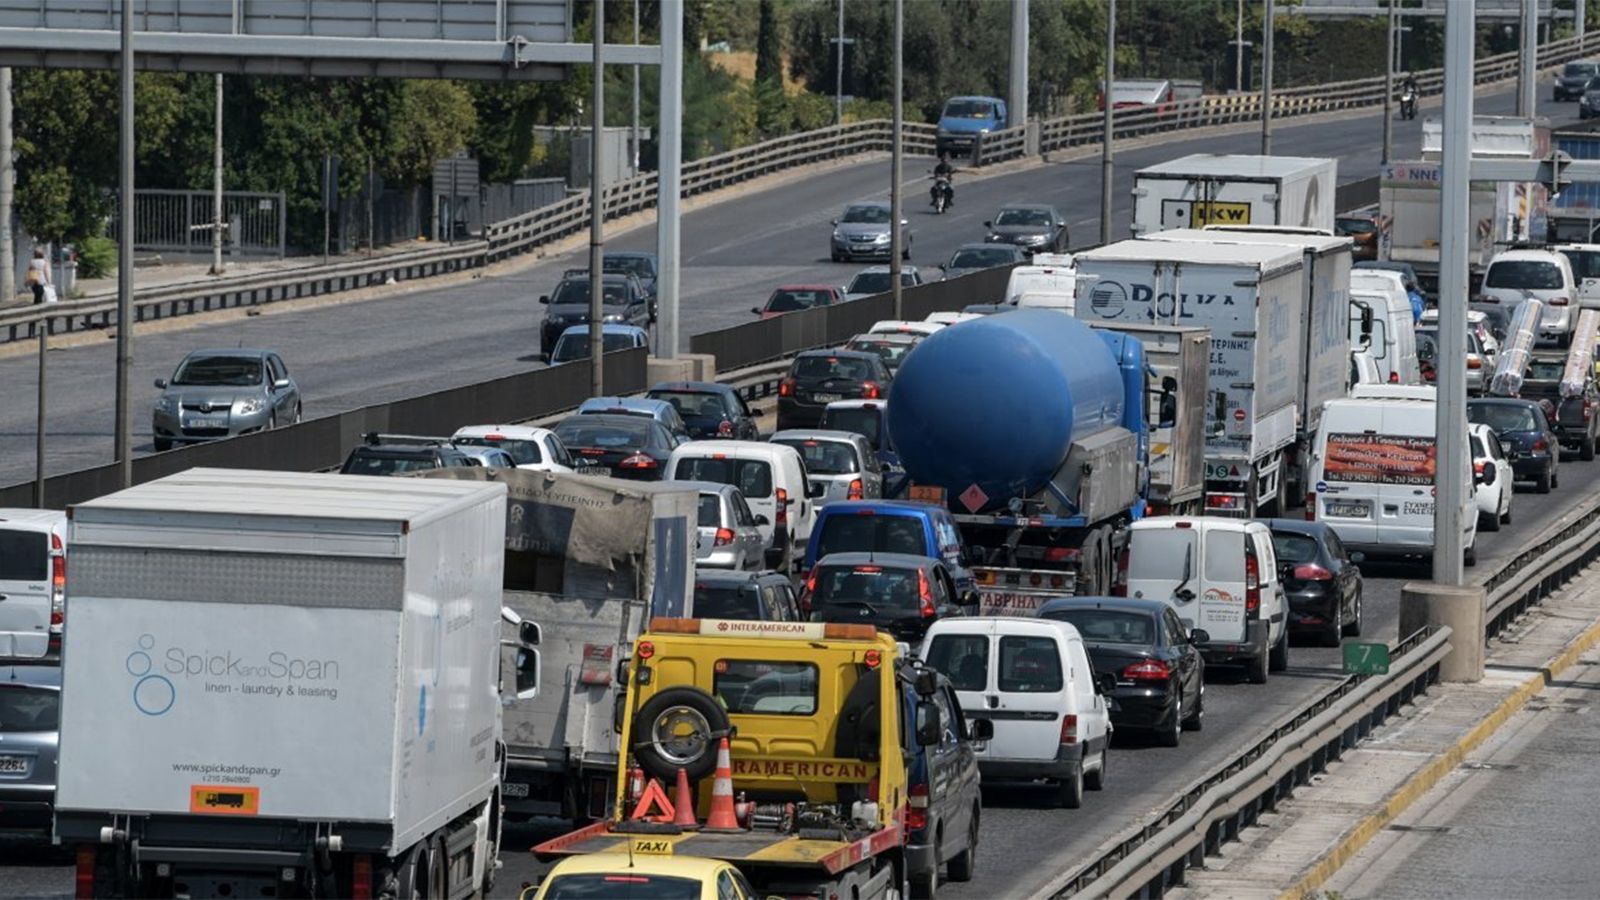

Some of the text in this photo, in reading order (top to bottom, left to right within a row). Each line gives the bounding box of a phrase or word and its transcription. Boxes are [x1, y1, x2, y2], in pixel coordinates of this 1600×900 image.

[730, 623, 805, 633] INTERAMERICAN
[1358, 645, 1372, 663] 7
[205, 682, 231, 694] linen
[242, 683, 283, 698] laundry
[286, 685, 295, 696] &
[297, 686, 338, 700] leasing
[172, 763, 281, 778] www.spickandspan.gr
[733, 760, 867, 778] RAMERICAN
[635, 841, 669, 852] TAXI
